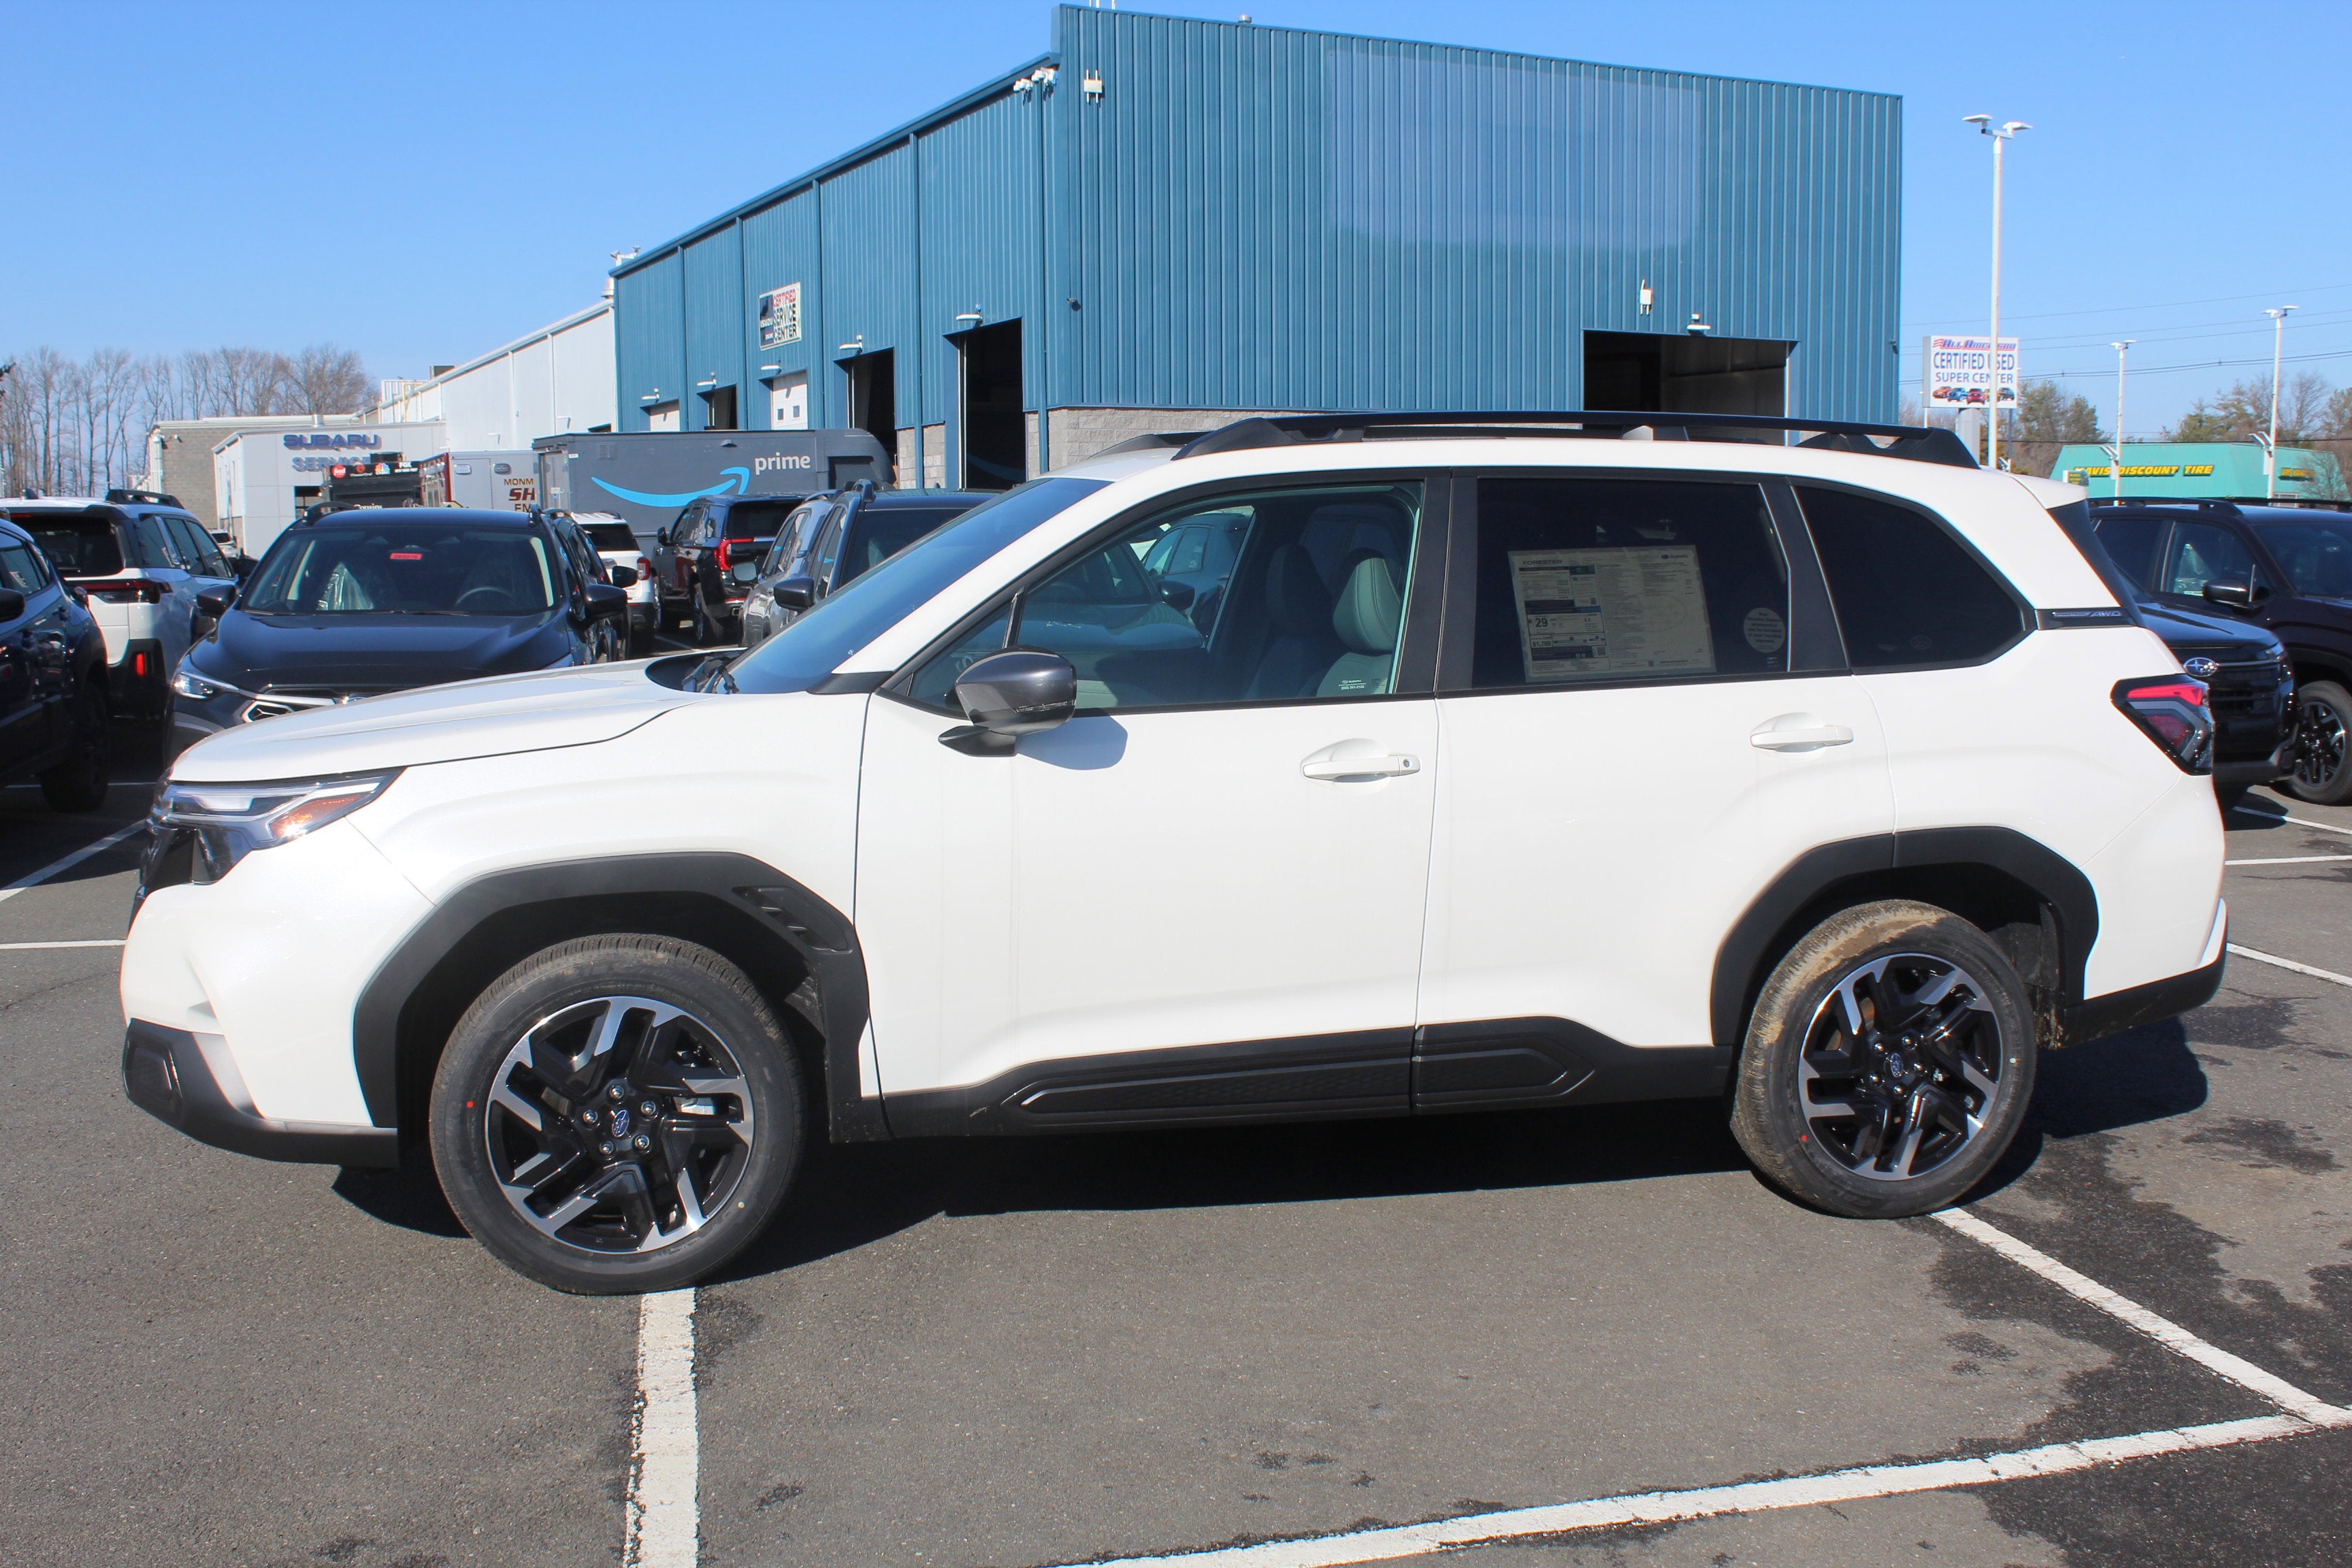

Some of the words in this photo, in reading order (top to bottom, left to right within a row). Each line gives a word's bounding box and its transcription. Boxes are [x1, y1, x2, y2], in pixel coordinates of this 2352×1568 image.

[773, 289, 796, 308] CERTIFIED
[774, 303, 797, 327] SERVICE
[760, 318, 773, 328] ISUZU
[774, 323, 797, 342] CENTER
[1933, 352, 1984, 369] CERTIFIED
[1935, 372, 1970, 382] SUPER
[284, 434, 379, 448] SUBARU
[755, 451, 811, 475] prime
[2119, 466, 2179, 475] DISCOUNT
[2184, 465, 2214, 474] TIRE
[334, 468, 346, 476] food
[1535, 618, 1548, 627] 29
